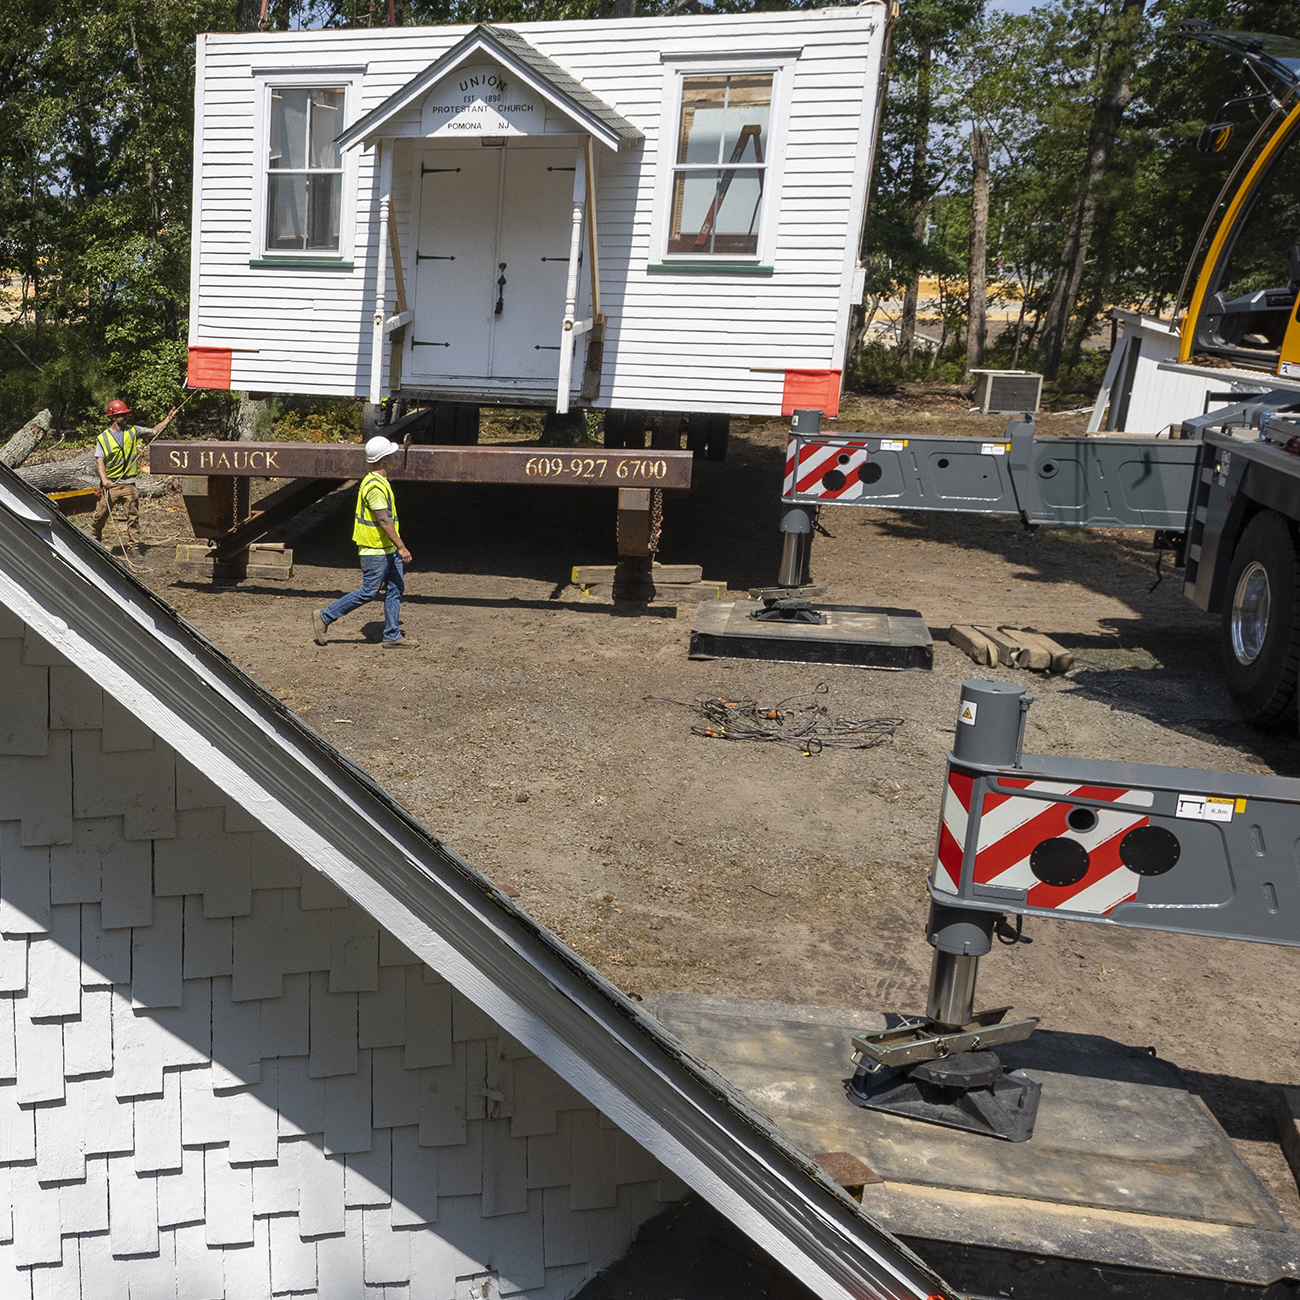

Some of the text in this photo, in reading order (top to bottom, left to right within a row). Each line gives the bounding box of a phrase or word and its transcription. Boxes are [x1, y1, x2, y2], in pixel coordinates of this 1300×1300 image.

[459, 75, 507, 92] UNION
[432, 104, 534, 114] PROTESTANT CHURCH
[447, 122, 482, 130] POMONA
[169, 450, 281, 470] SJ HAUCK
[525, 457, 667, 480] 609-927 6700
